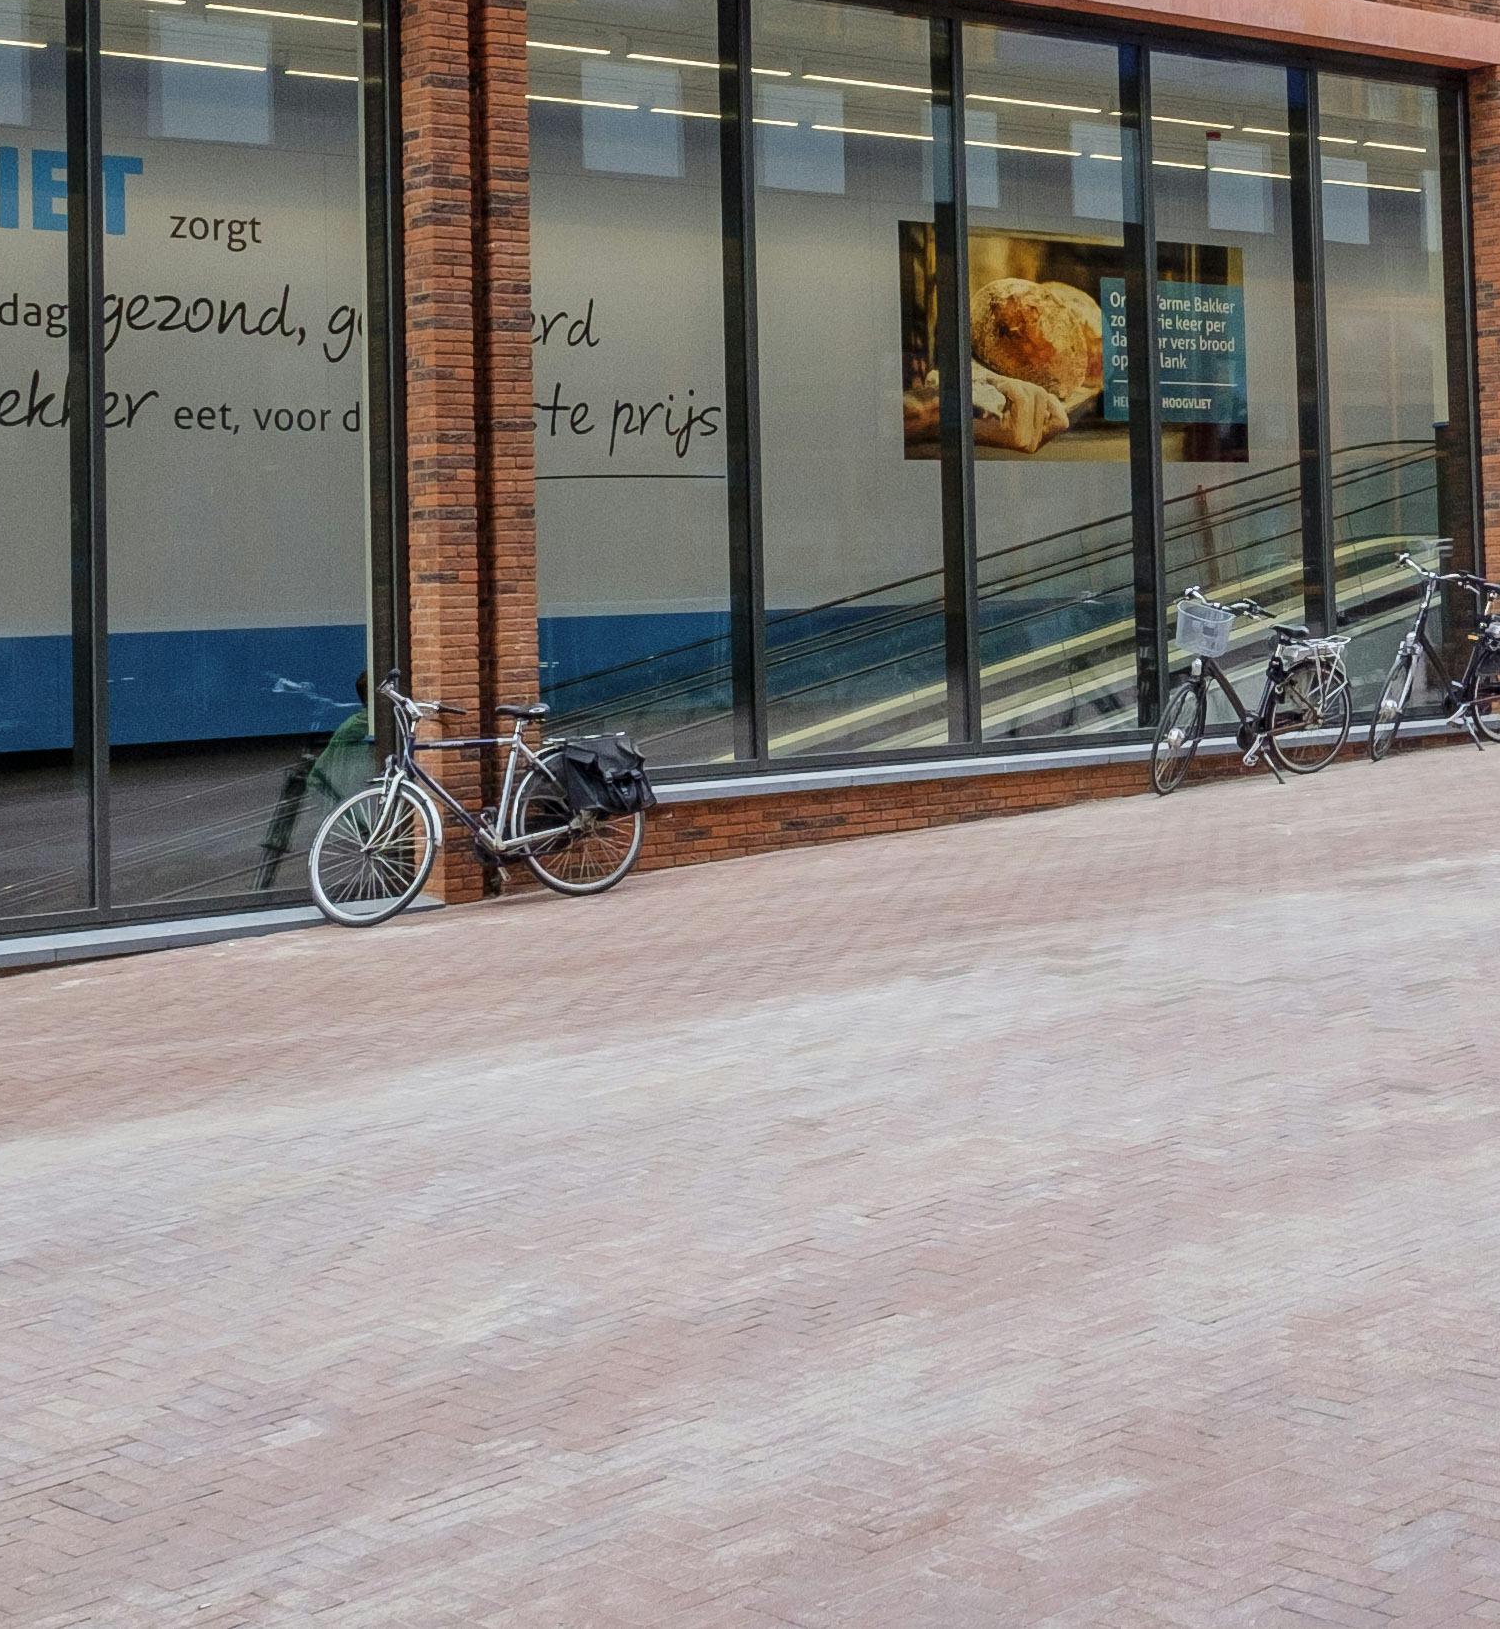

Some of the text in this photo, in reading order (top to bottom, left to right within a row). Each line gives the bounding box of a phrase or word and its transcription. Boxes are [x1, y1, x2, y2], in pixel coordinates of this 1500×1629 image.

[169, 215, 262, 252] zorgt
[1156, 294, 1191, 312] arme
[1193, 296, 1236, 314] Bakker
[1175, 314, 1203, 331] keer
[1205, 320, 1227, 336] per
[1170, 337, 1197, 351] vers
[1199, 335, 1236, 352] brood
[1161, 396, 1212, 410] HOOGVLIET
[173, 402, 241, 436] eet,
[252, 408, 332, 432] voor
[608, 389, 722, 459] prijs
